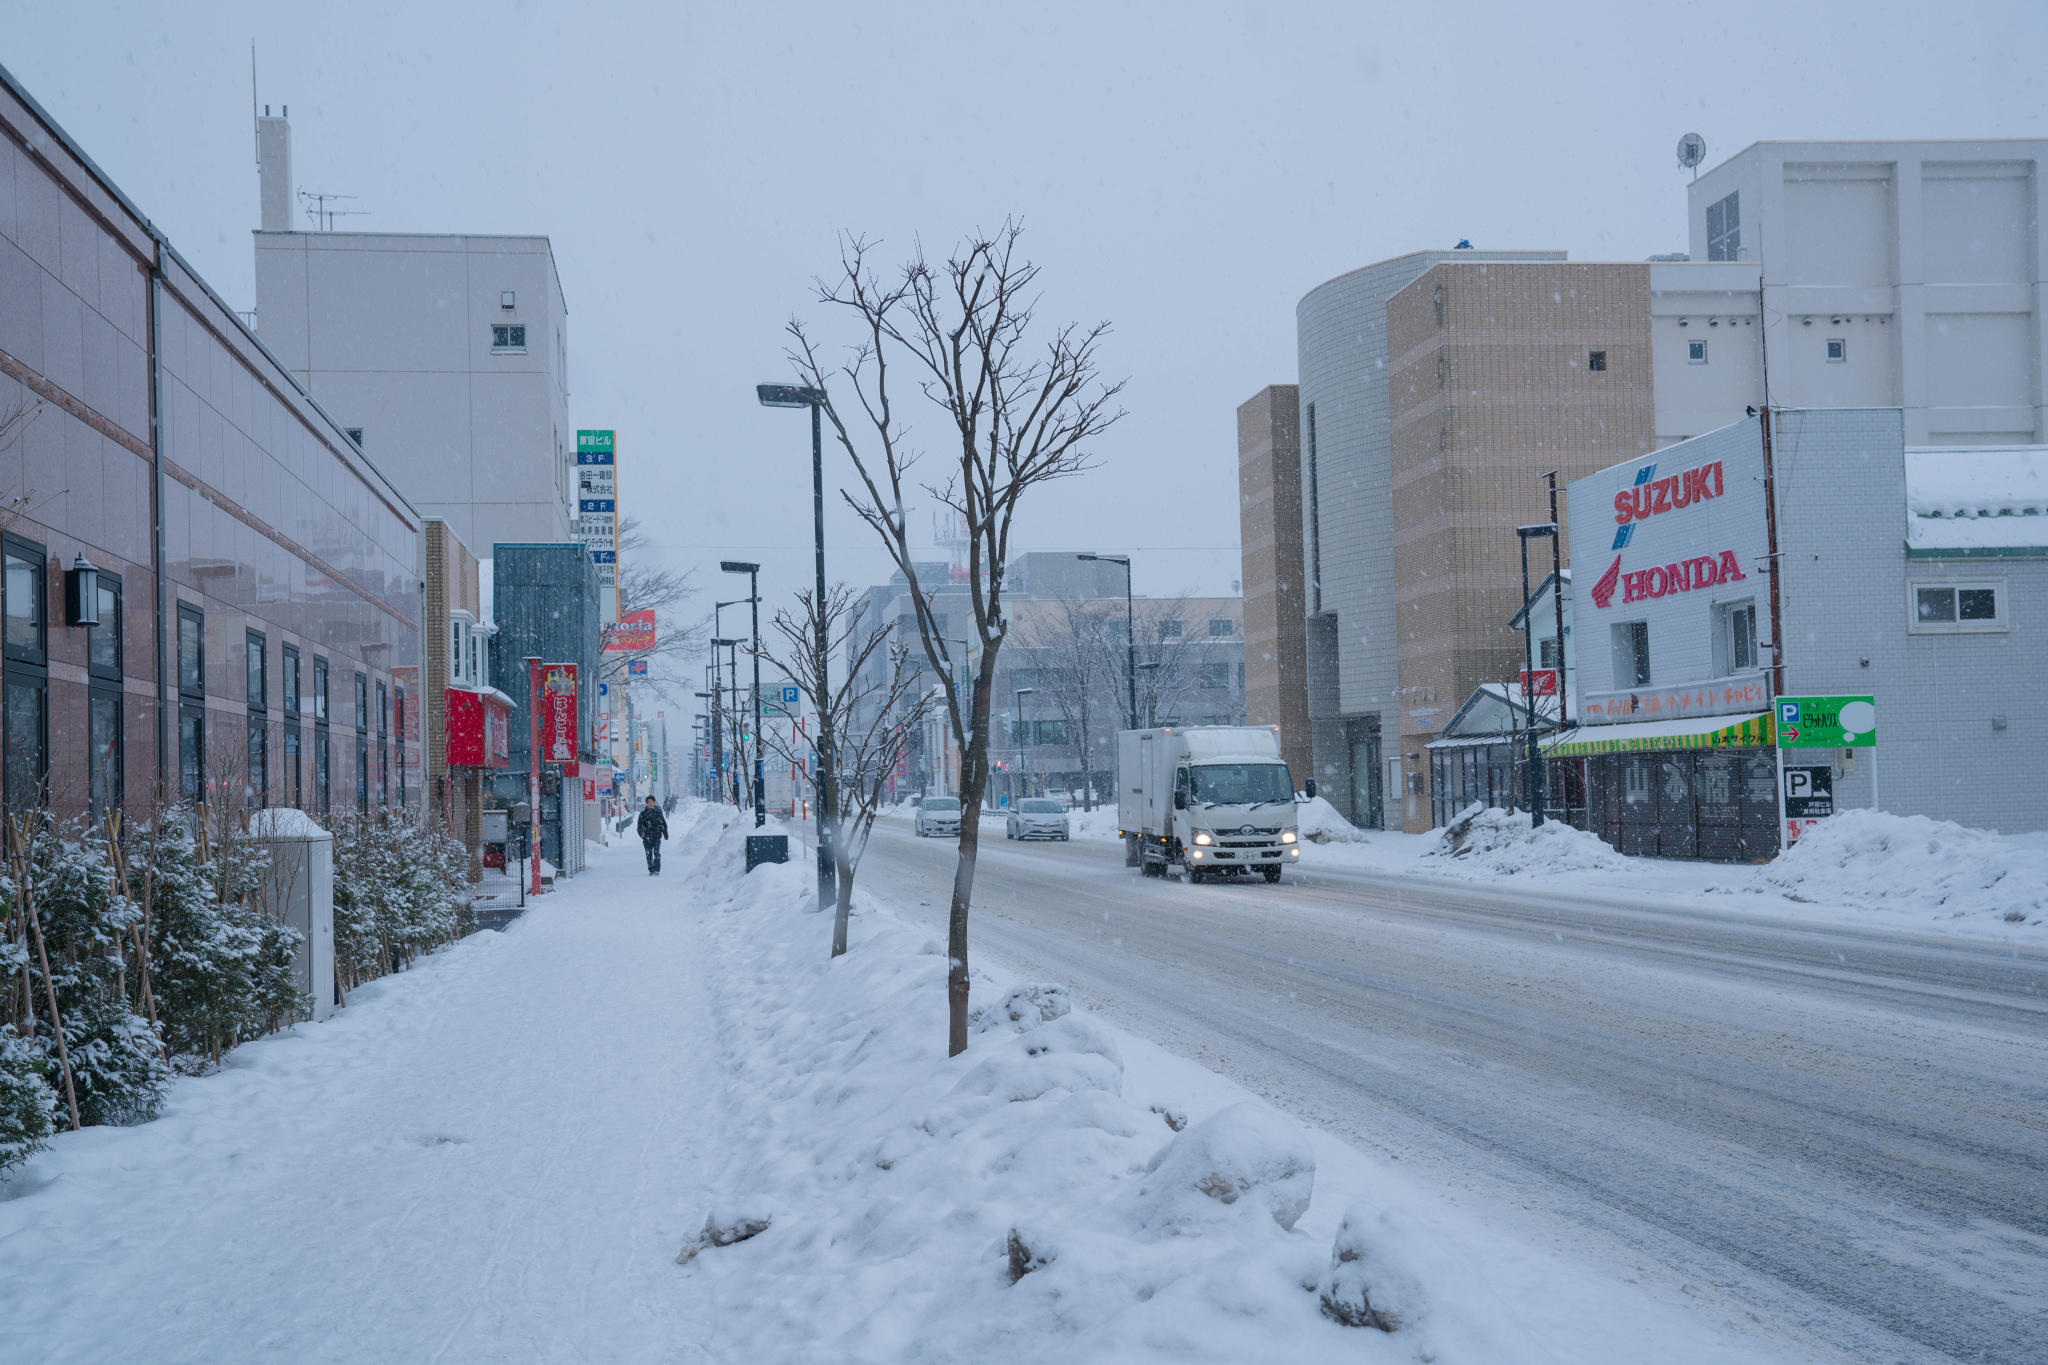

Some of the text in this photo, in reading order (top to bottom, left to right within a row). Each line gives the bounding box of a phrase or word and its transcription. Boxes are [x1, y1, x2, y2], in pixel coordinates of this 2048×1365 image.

[1614, 460, 1724, 524] SUZUKI
[1620, 549, 1747, 603] HONDA
[1641, 694, 1675, 713] スポーツ
[1782, 704, 1797, 721] P
[1803, 712, 1838, 728] ピタットハウス
[1712, 733, 1765, 744] 山本サイクル
[1790, 773, 1808, 796] P
